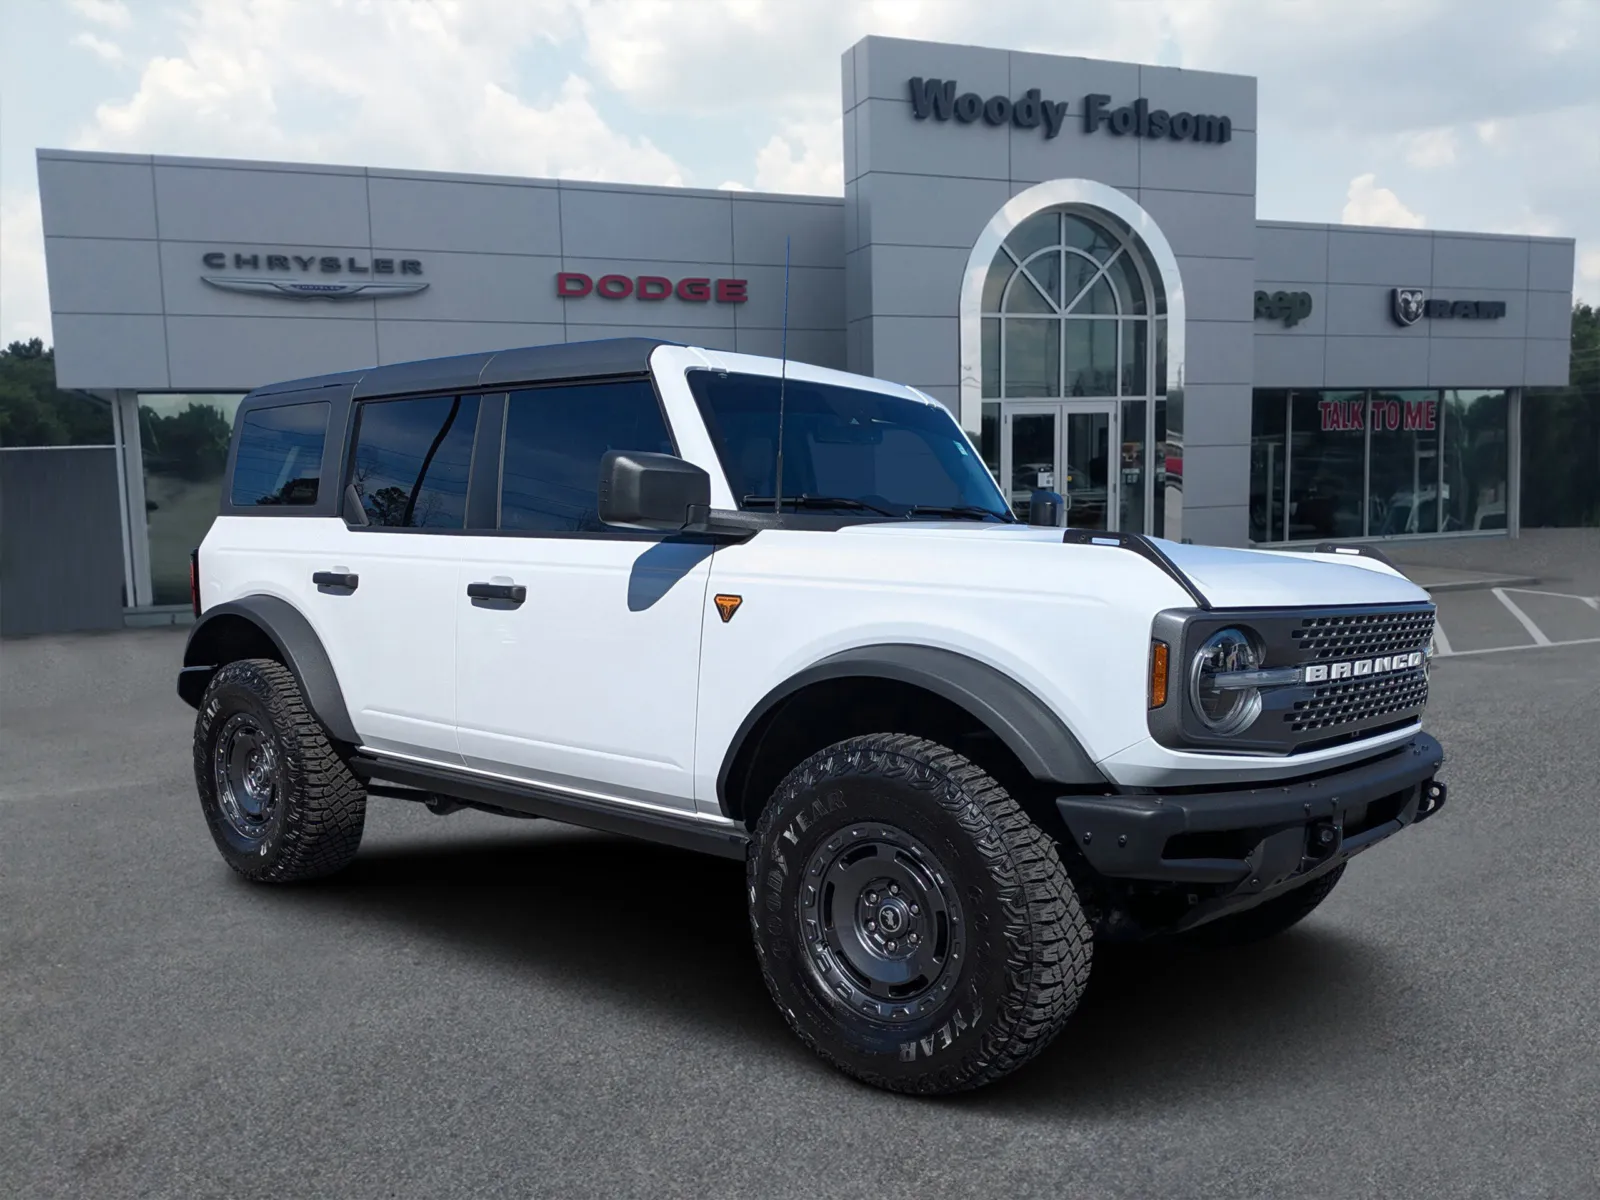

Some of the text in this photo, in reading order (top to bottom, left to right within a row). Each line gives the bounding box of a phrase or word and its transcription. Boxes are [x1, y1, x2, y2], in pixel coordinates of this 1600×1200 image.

[909, 76, 1232, 144] Woody Folsom
[202, 252, 423, 275] CHRYSLER
[557, 272, 749, 303] DODGE
[1254, 290, 1312, 328] eep
[1425, 300, 1506, 319] RAM
[1318, 400, 1436, 431] TALK TO ME
[1305, 652, 1422, 682] BRONCO
